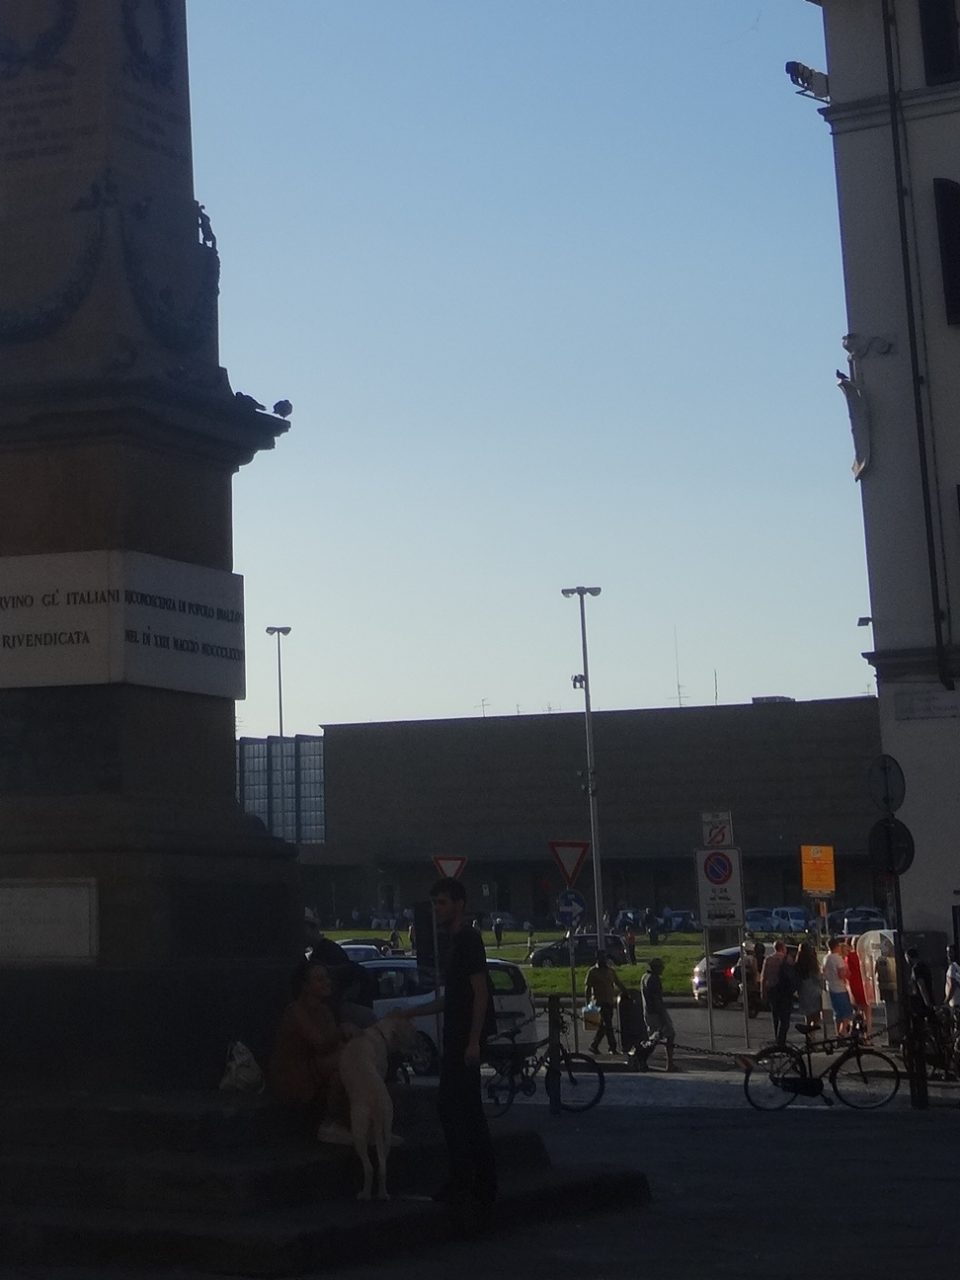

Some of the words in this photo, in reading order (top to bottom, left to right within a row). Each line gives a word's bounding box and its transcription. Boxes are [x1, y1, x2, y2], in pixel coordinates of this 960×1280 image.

[67, 589, 120, 606] ITALIANI
[124, 589, 177, 612] RICONOSCENZA
[178, 600, 186, 614] DI
[188, 602, 214, 619] POPOLO
[2, 631, 91, 650] RIVENDICATA
